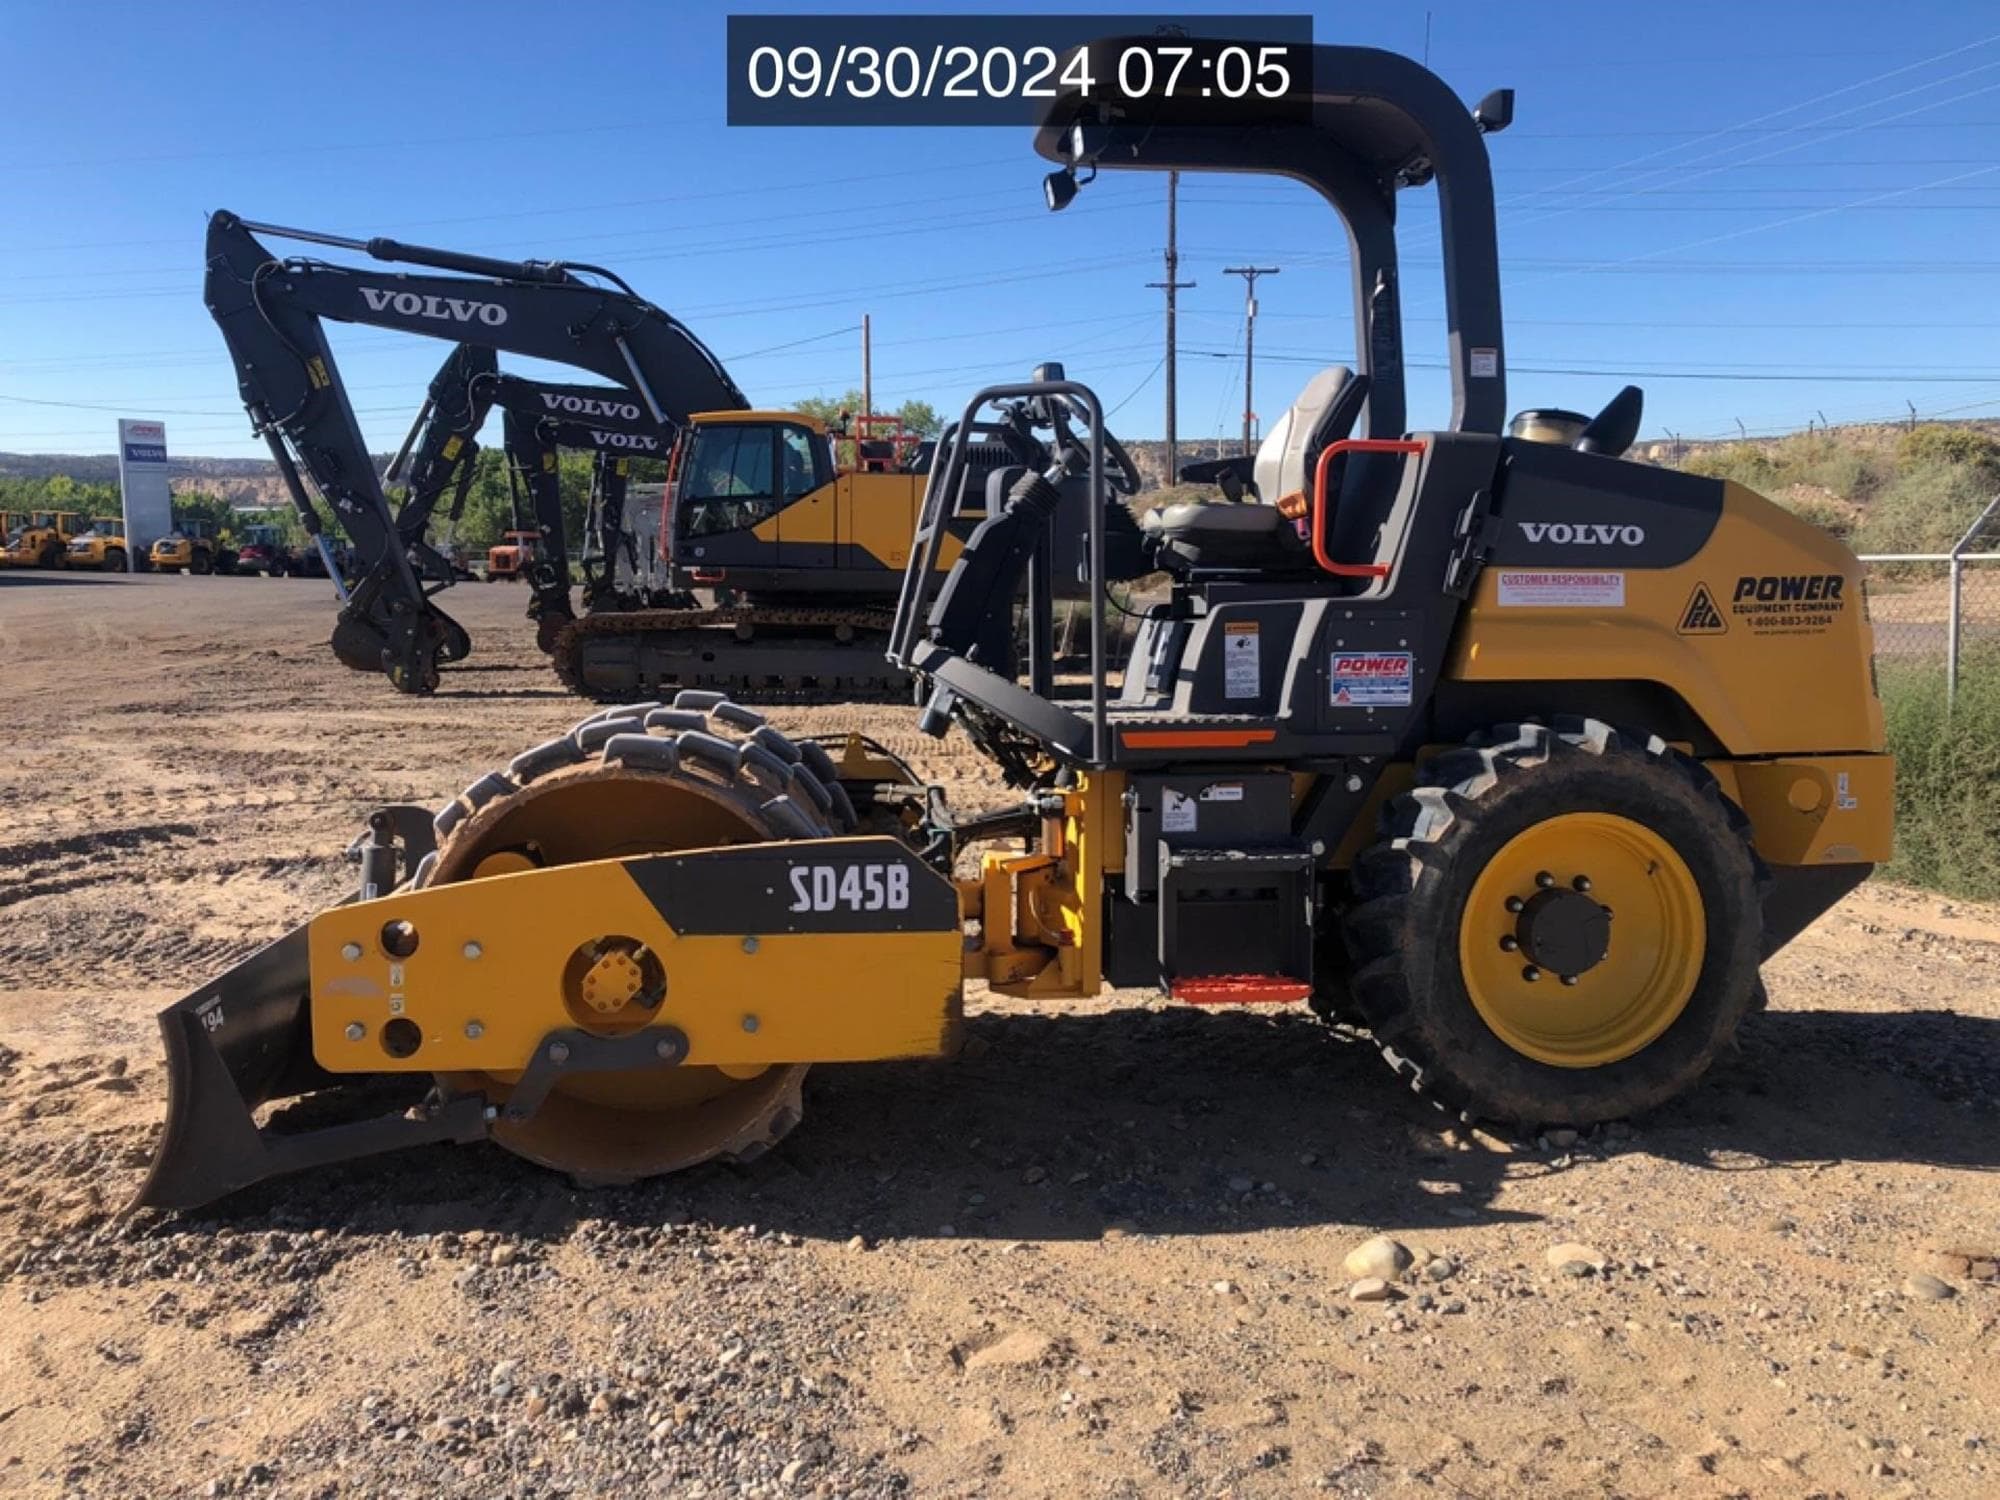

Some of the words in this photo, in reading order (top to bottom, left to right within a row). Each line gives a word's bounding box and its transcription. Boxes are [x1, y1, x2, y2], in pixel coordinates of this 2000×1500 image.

[359, 286, 509, 327] VOLVO
[540, 393, 641, 420] VOLVO
[589, 430, 659, 450] VOLV
[1518, 522, 1645, 546] VOLVO
[1501, 574, 1549, 586] CUSTOMER
[1551, 574, 1621, 586] RESPONSIBILITY
[1733, 575, 1844, 602] POWER
[1732, 603, 1791, 615] EQUIPMENT
[1795, 601, 1844, 613] COMPANY
[1336, 658, 1408, 671] POWER
[789, 864, 909, 912] SD45B
